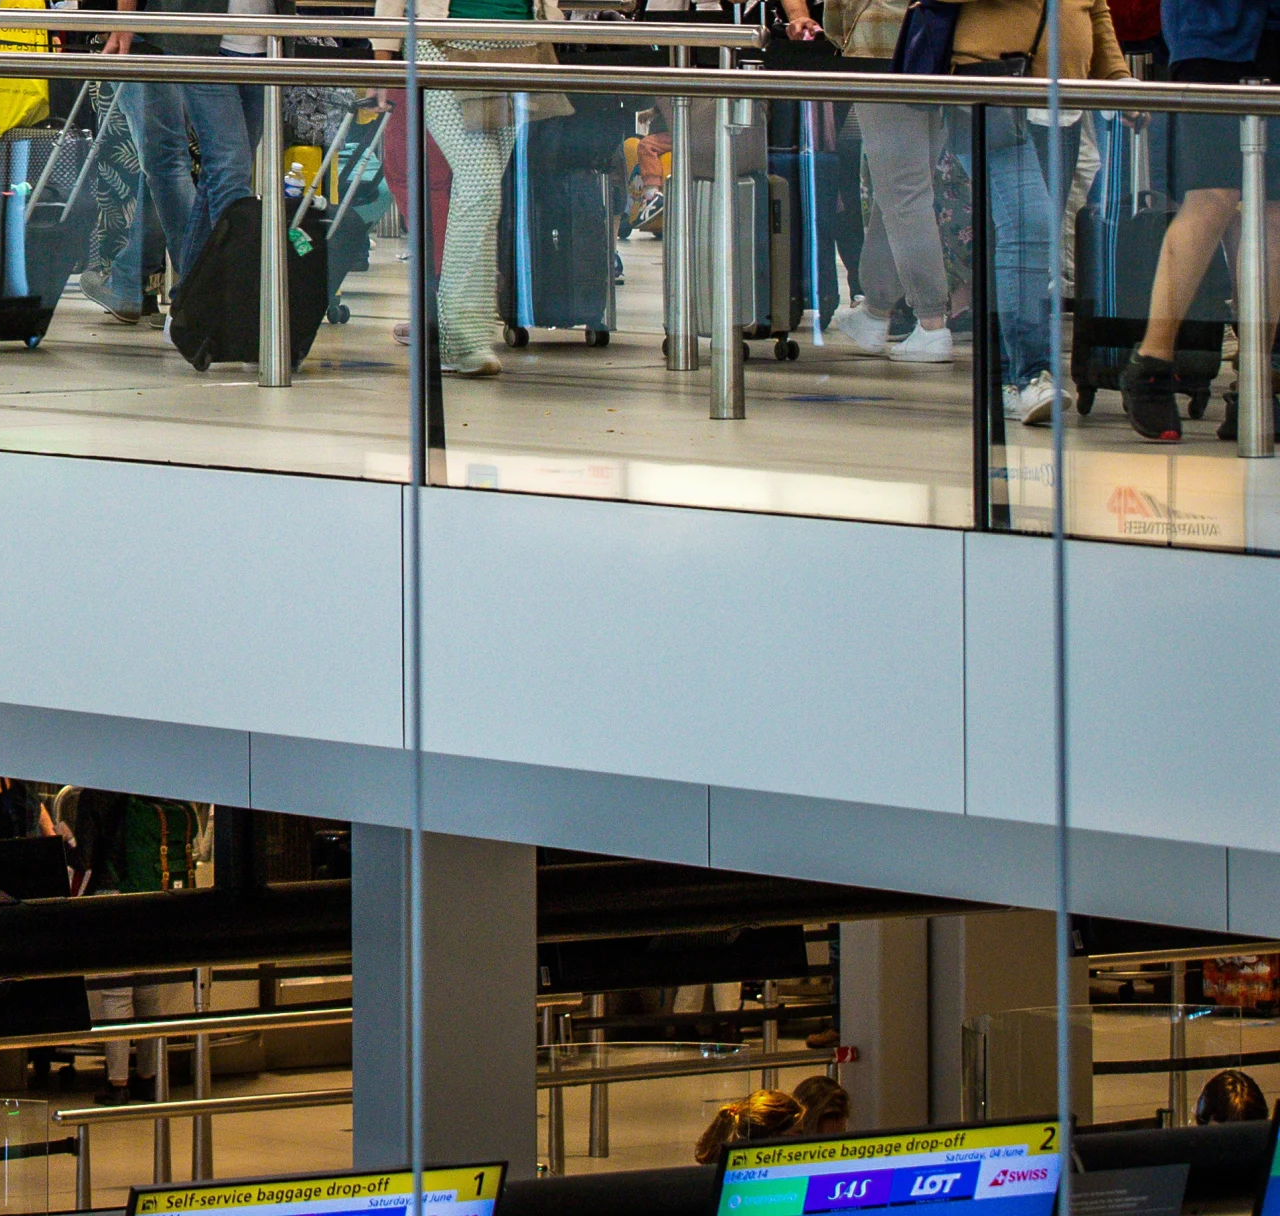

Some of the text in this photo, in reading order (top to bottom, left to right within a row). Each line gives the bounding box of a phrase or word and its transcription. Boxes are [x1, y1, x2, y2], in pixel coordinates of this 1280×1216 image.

[754, 1126, 1056, 1166] Self-service baggage drop-off 2
[945, 1146, 1024, 1163] Saturday, 04 June
[166, 1171, 486, 1210] Self-service baggage drop-off 1
[367, 1196, 413, 1209] Saturday,
[430, 1191, 453, 1204] June
[828, 1179, 872, 1200] SAS
[910, 1172, 962, 1196] LOT
[1008, 1168, 1049, 1183] SWISS
